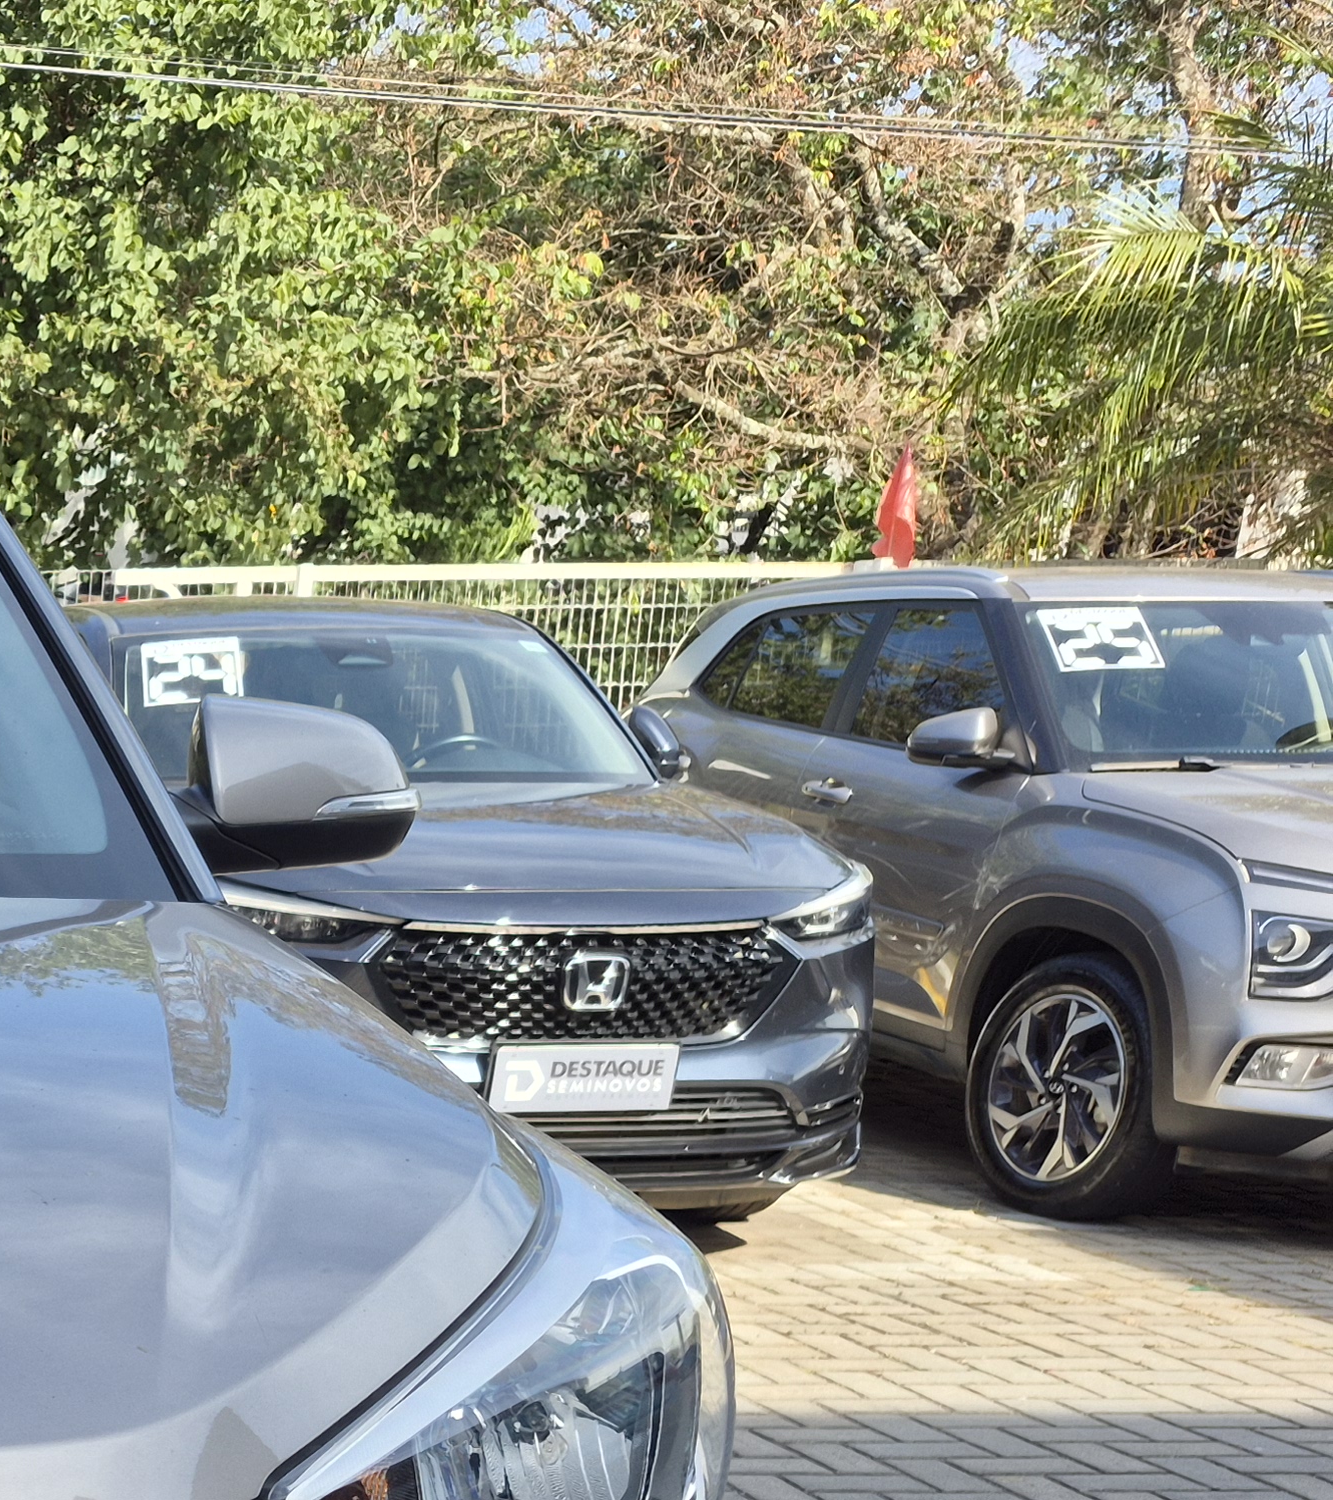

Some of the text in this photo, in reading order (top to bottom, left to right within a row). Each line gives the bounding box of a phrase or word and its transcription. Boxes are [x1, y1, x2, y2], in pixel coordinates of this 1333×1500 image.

[148, 653, 238, 703] 24
[550, 1059, 665, 1079] DESTAQUE
[546, 1077, 663, 1094] SEMINOVOS
